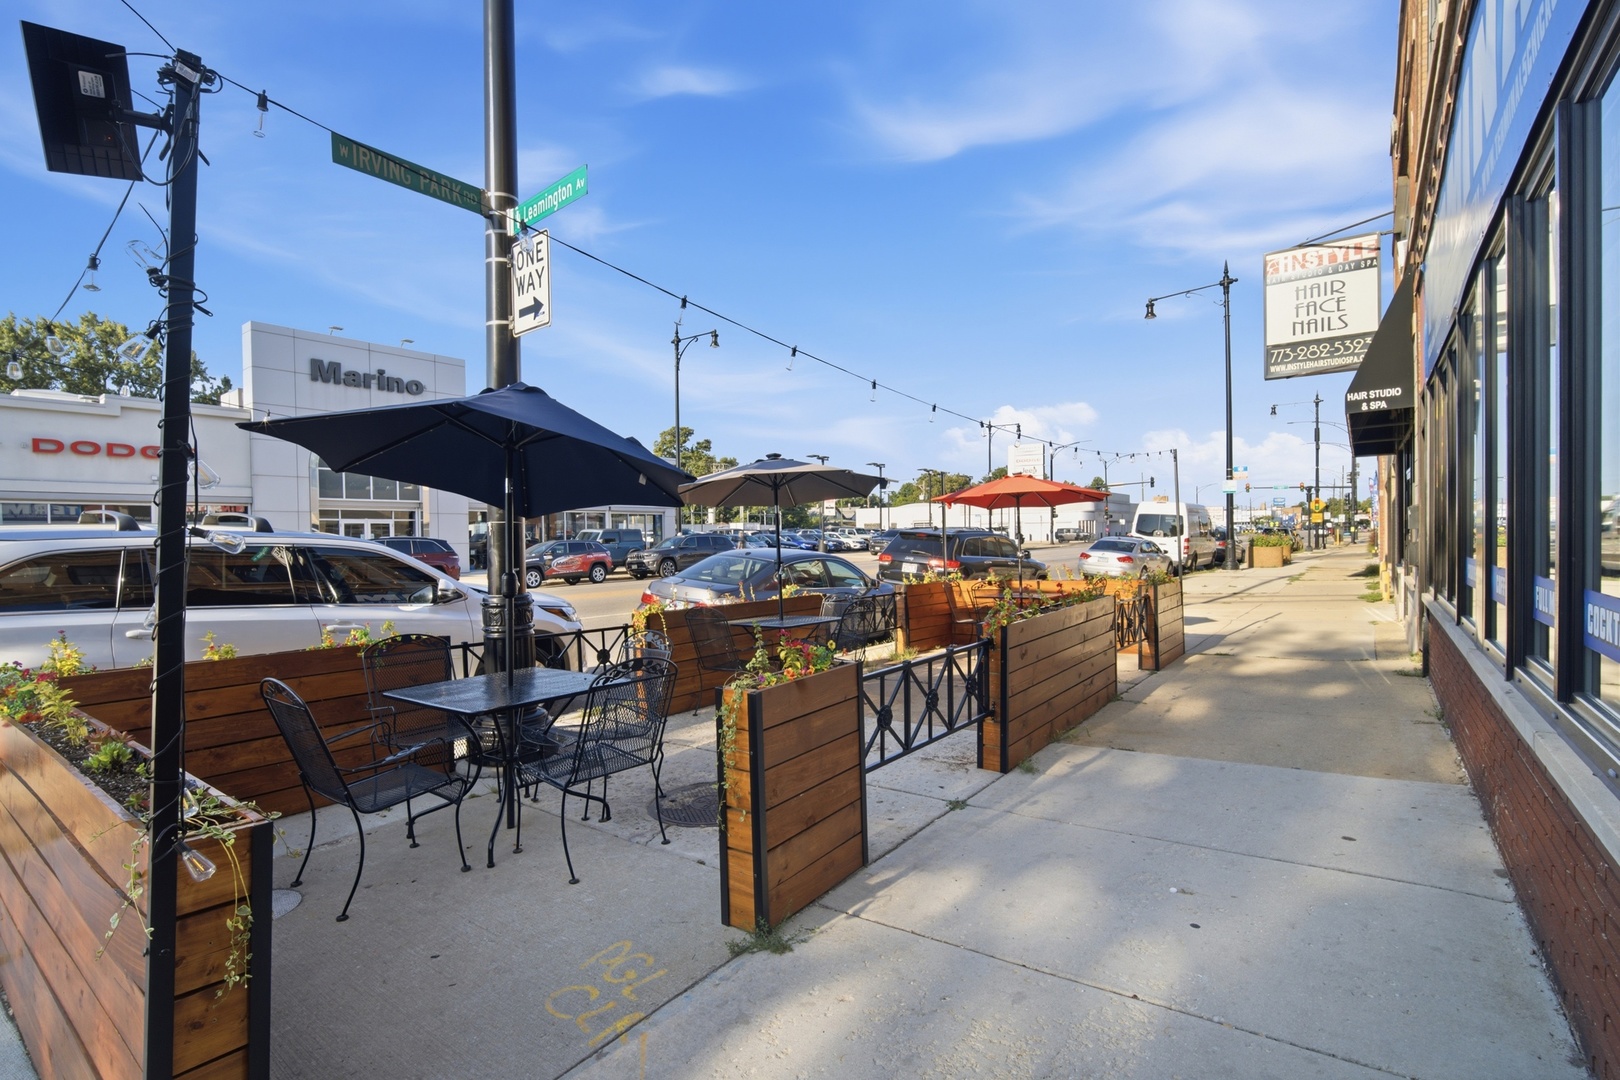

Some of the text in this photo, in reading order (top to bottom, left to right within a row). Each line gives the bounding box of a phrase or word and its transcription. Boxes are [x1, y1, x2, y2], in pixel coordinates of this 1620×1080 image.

[339, 143, 478, 205] W IRVING PARK RD
[523, 182, 573, 222] Leamington
[575, 177, 585, 191] Av
[516, 240, 544, 271] ONE
[1291, 269, 1323, 280] STUDIO
[1338, 262, 1356, 272] DAY
[1360, 259, 1378, 268] SPA
[516, 266, 545, 297] WAY
[1295, 280, 1346, 301] HAIR
[1294, 296, 1346, 318] FACE
[1292, 314, 1348, 336] NAILS
[1270, 354, 1365, 373] WWW.INSTYLEHAIRSTUDIOSPA.C
[310, 358, 425, 396] Marino
[1347, 387, 1402, 401] HAIR STUDIO
[1361, 400, 1387, 411] & SPA
[32, 438, 161, 459] DODG
[1587, 603, 1620, 648] COCKT
